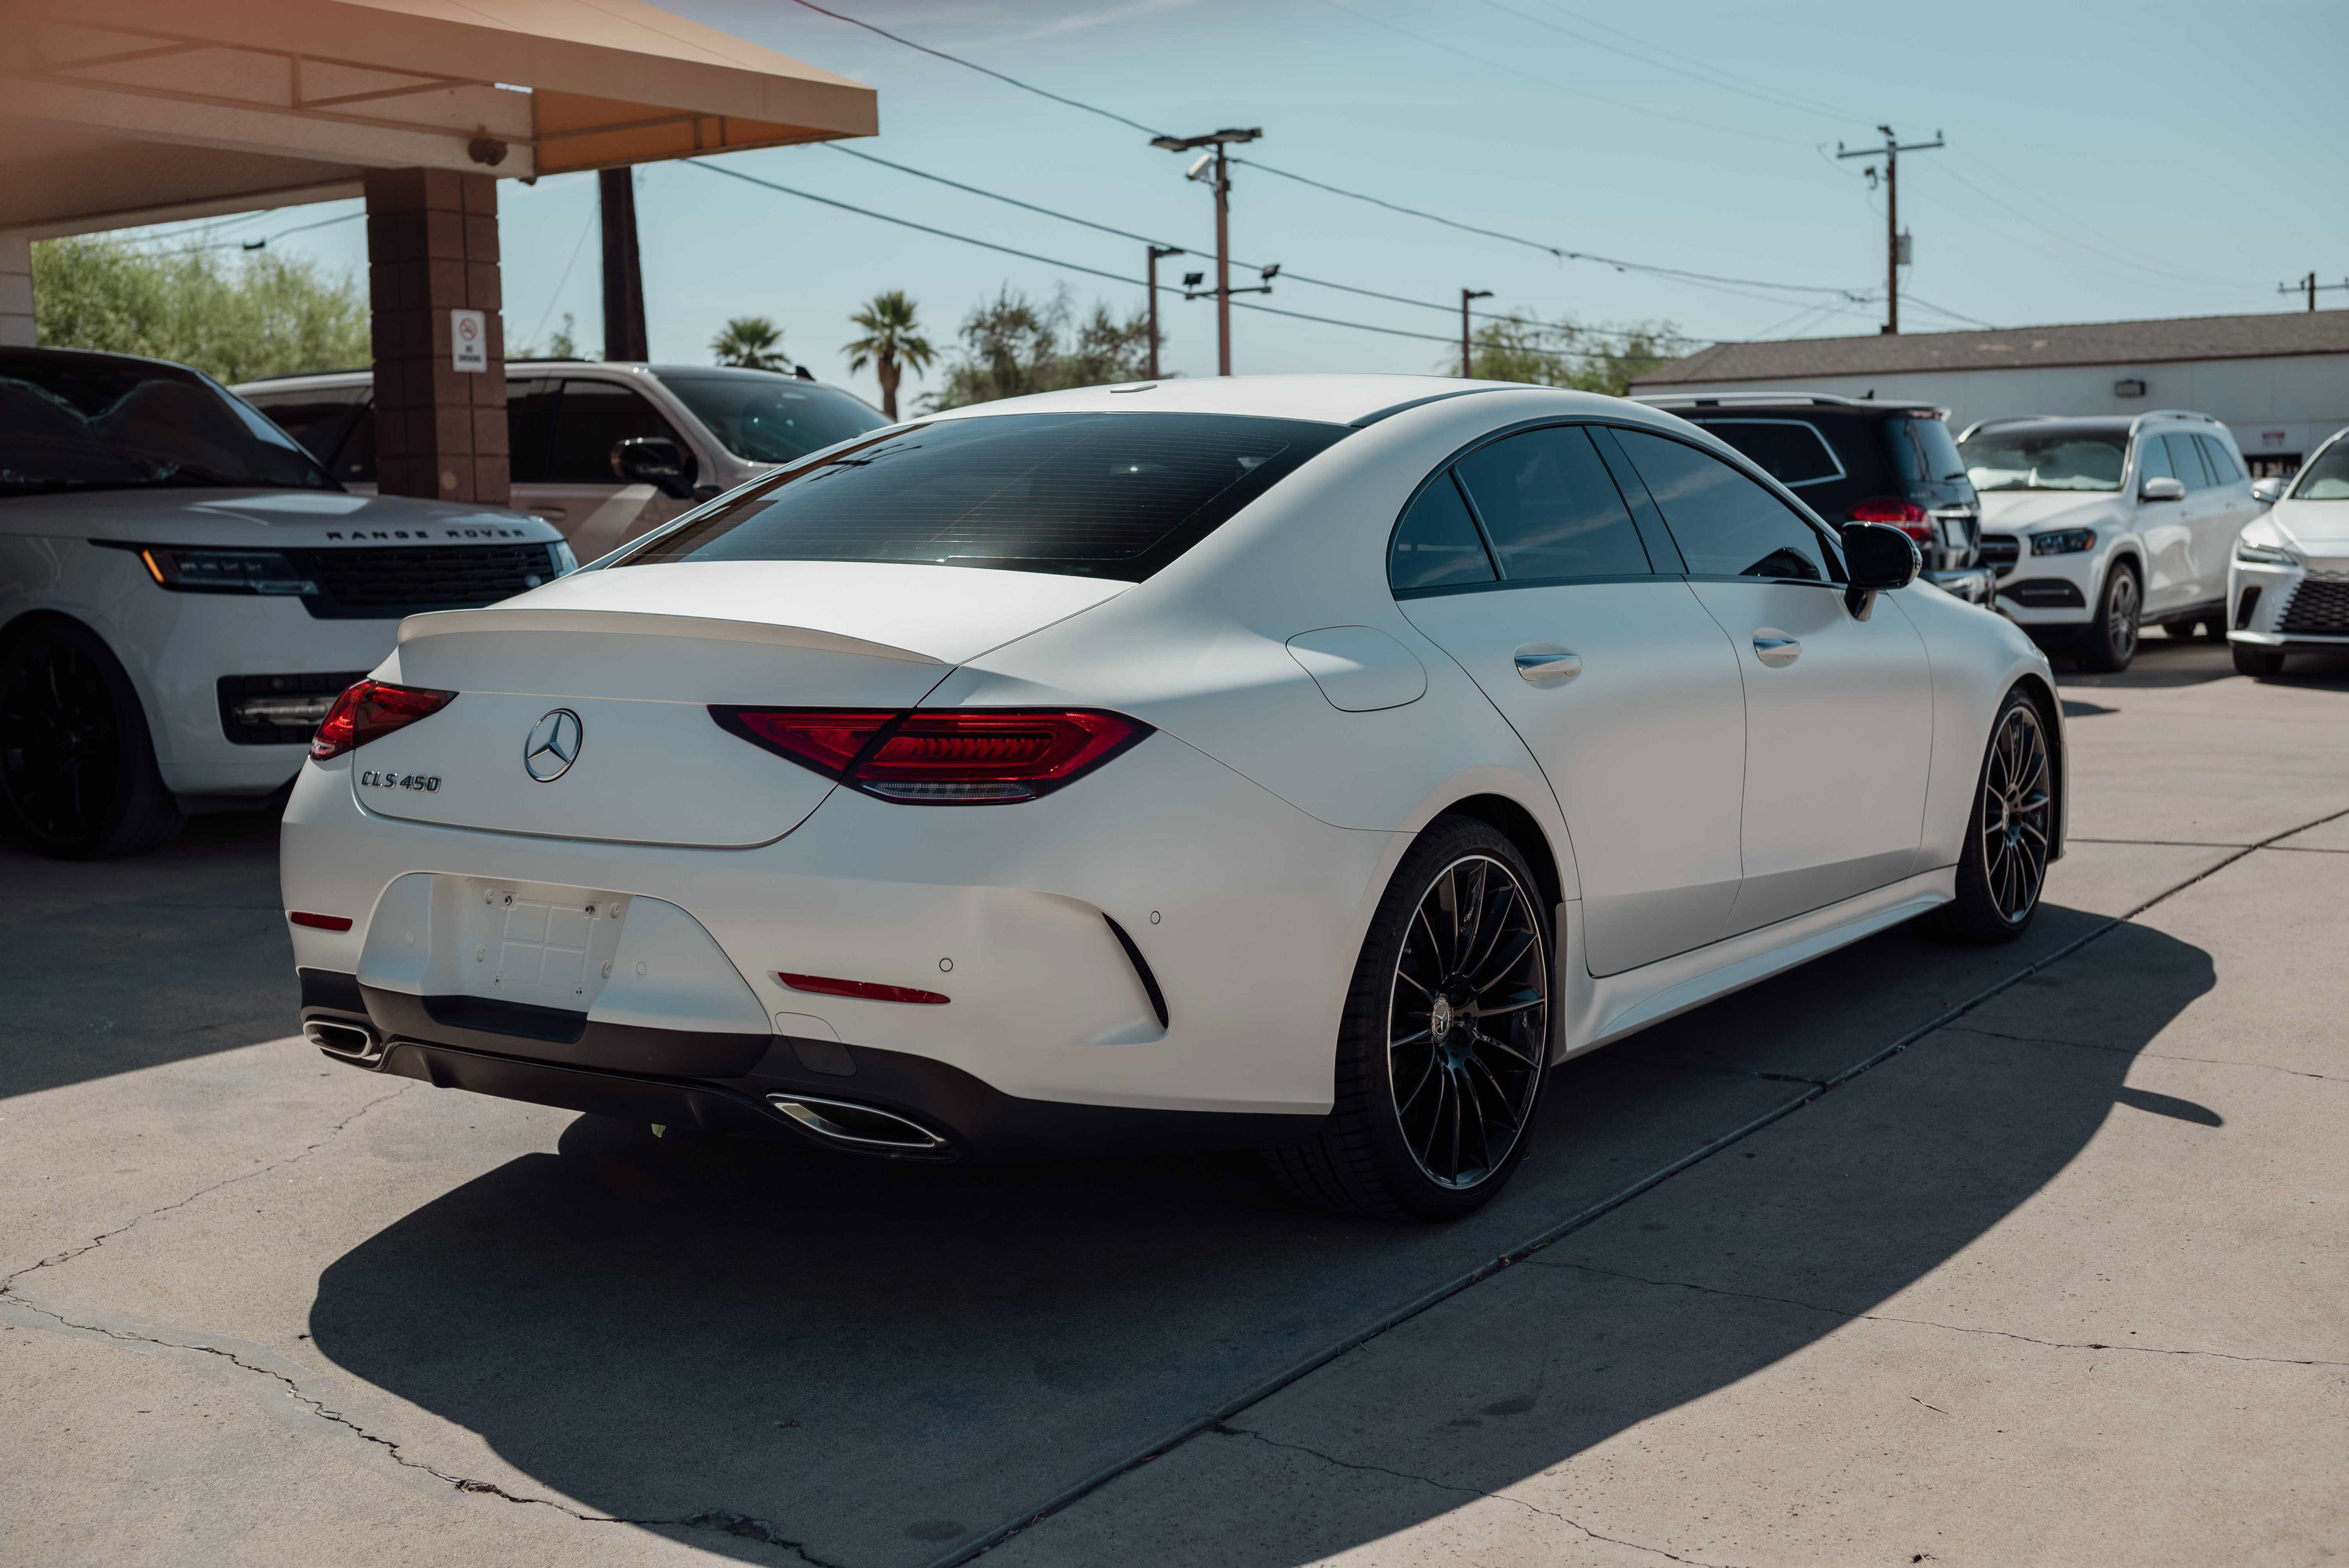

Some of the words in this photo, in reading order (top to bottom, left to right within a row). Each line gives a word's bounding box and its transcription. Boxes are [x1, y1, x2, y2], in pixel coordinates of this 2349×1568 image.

[326, 531, 429, 541] RANGE
[445, 529, 526, 539] ROVER
[362, 771, 398, 789] CLS
[399, 774, 442, 793] 450
